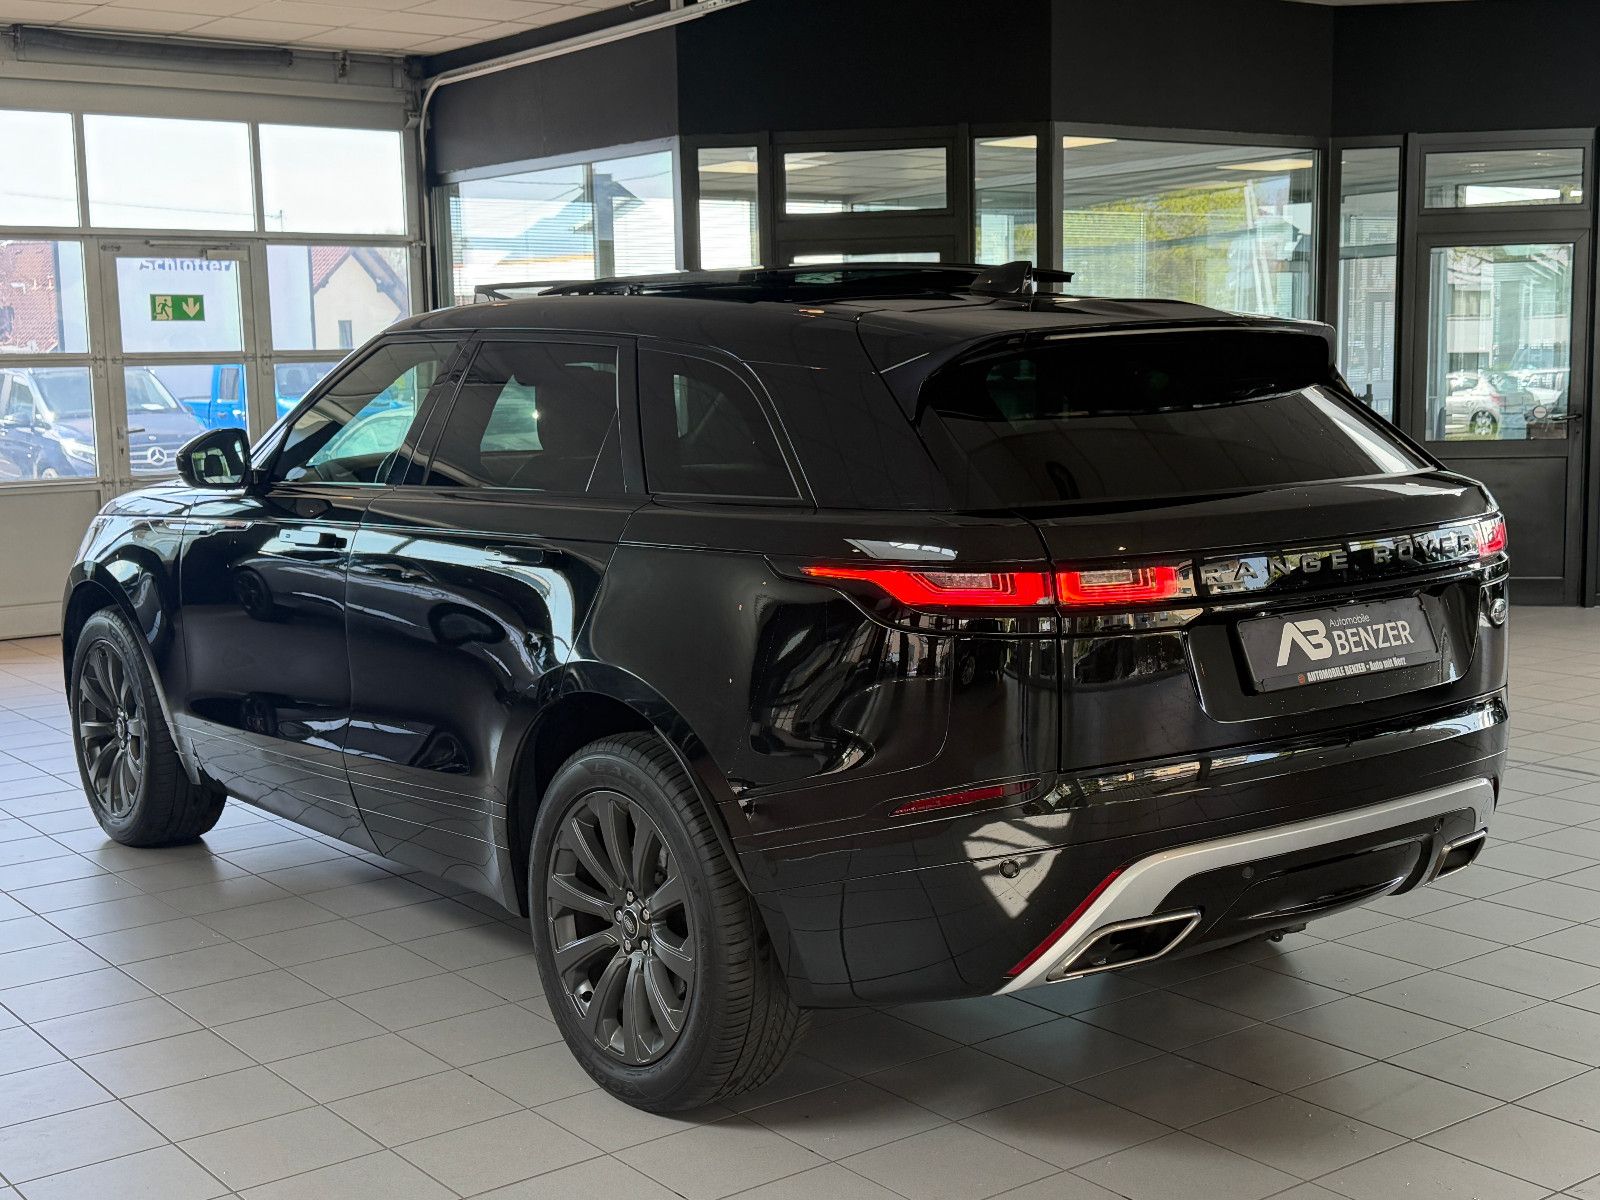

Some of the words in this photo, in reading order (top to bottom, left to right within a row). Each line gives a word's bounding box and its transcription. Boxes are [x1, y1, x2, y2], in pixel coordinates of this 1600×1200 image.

[1200, 552, 1349, 585] RANGE
[1373, 533, 1475, 565] ROVER
[1329, 613, 1371, 628] Automobile
[1331, 620, 1415, 656] BENZER
[1306, 665, 1346, 683] AUTOMOBILE
[1344, 662, 1367, 676] BENZER
